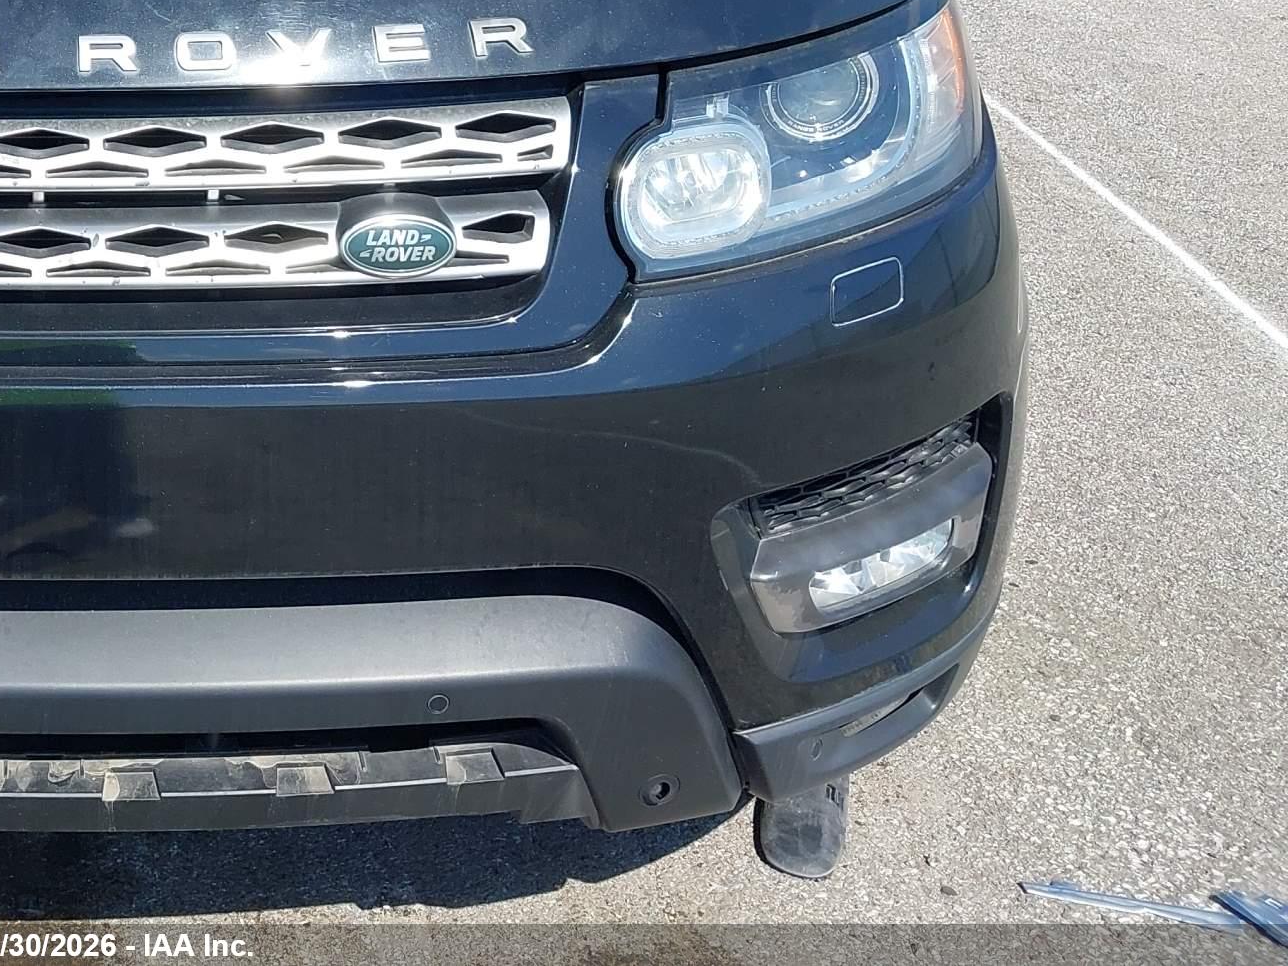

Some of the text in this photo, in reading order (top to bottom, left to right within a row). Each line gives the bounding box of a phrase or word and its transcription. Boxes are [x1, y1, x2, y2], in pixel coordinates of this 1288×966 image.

[76, 17, 535, 75] ROVER
[365, 229, 420, 246] LAND
[371, 246, 436, 263] ROVER
